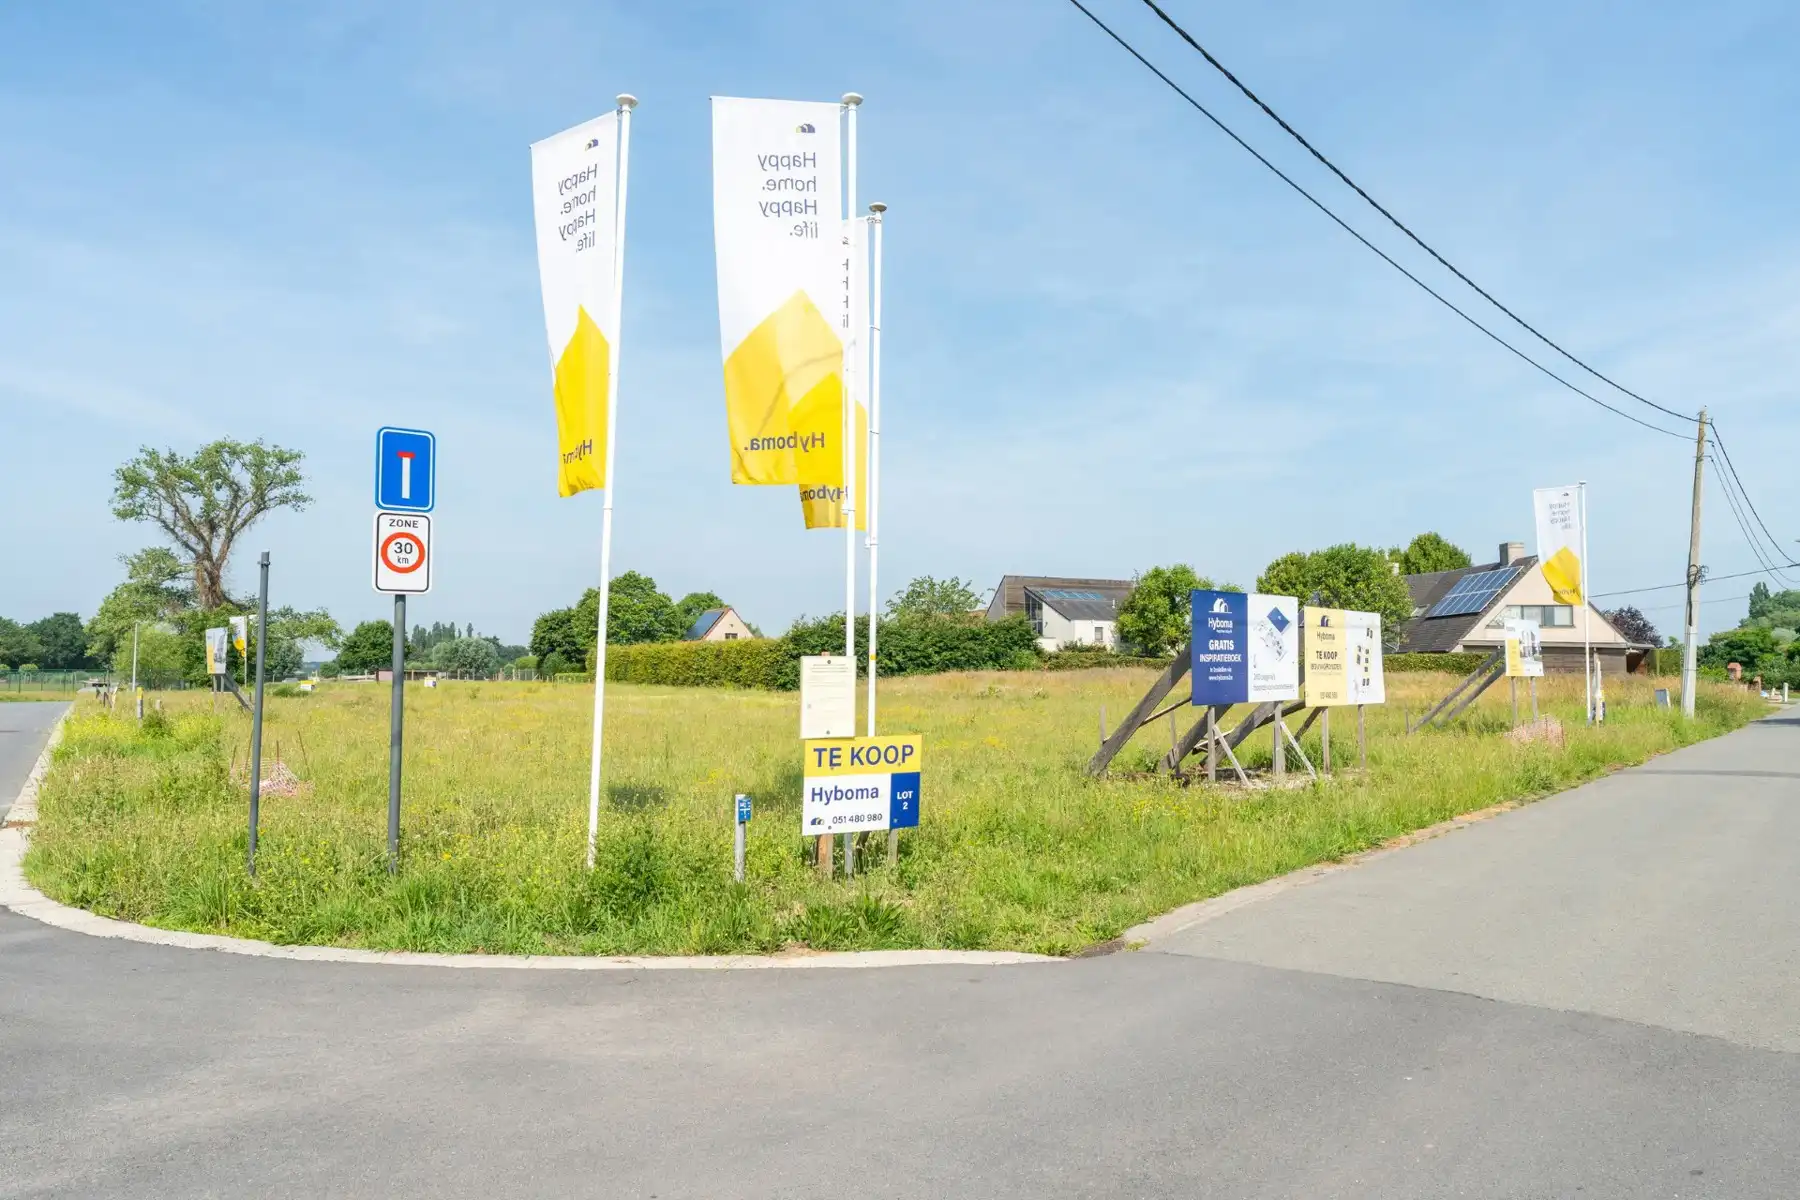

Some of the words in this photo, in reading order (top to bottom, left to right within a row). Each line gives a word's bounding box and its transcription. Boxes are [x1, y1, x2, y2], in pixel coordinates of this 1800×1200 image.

[389, 519, 419, 528] ZONE
[394, 542, 413, 554] 30
[397, 556, 409, 564] km
[1207, 617, 1234, 631] Hyboma
[1208, 640, 1234, 650] GRATIS
[1199, 654, 1242, 663] INSPIRATIEBOEK
[1316, 650, 1322, 660] TE
[1324, 650, 1338, 660] KOOP
[813, 746, 842, 768] TE
[850, 744, 914, 767] KOOP
[810, 785, 880, 806] Hyboma
[896, 790, 913, 800] LOT
[902, 802, 909, 810] 2
[832, 815, 847, 824] 051
[848, 814, 865, 823] 480
[867, 813, 883, 822] 980
